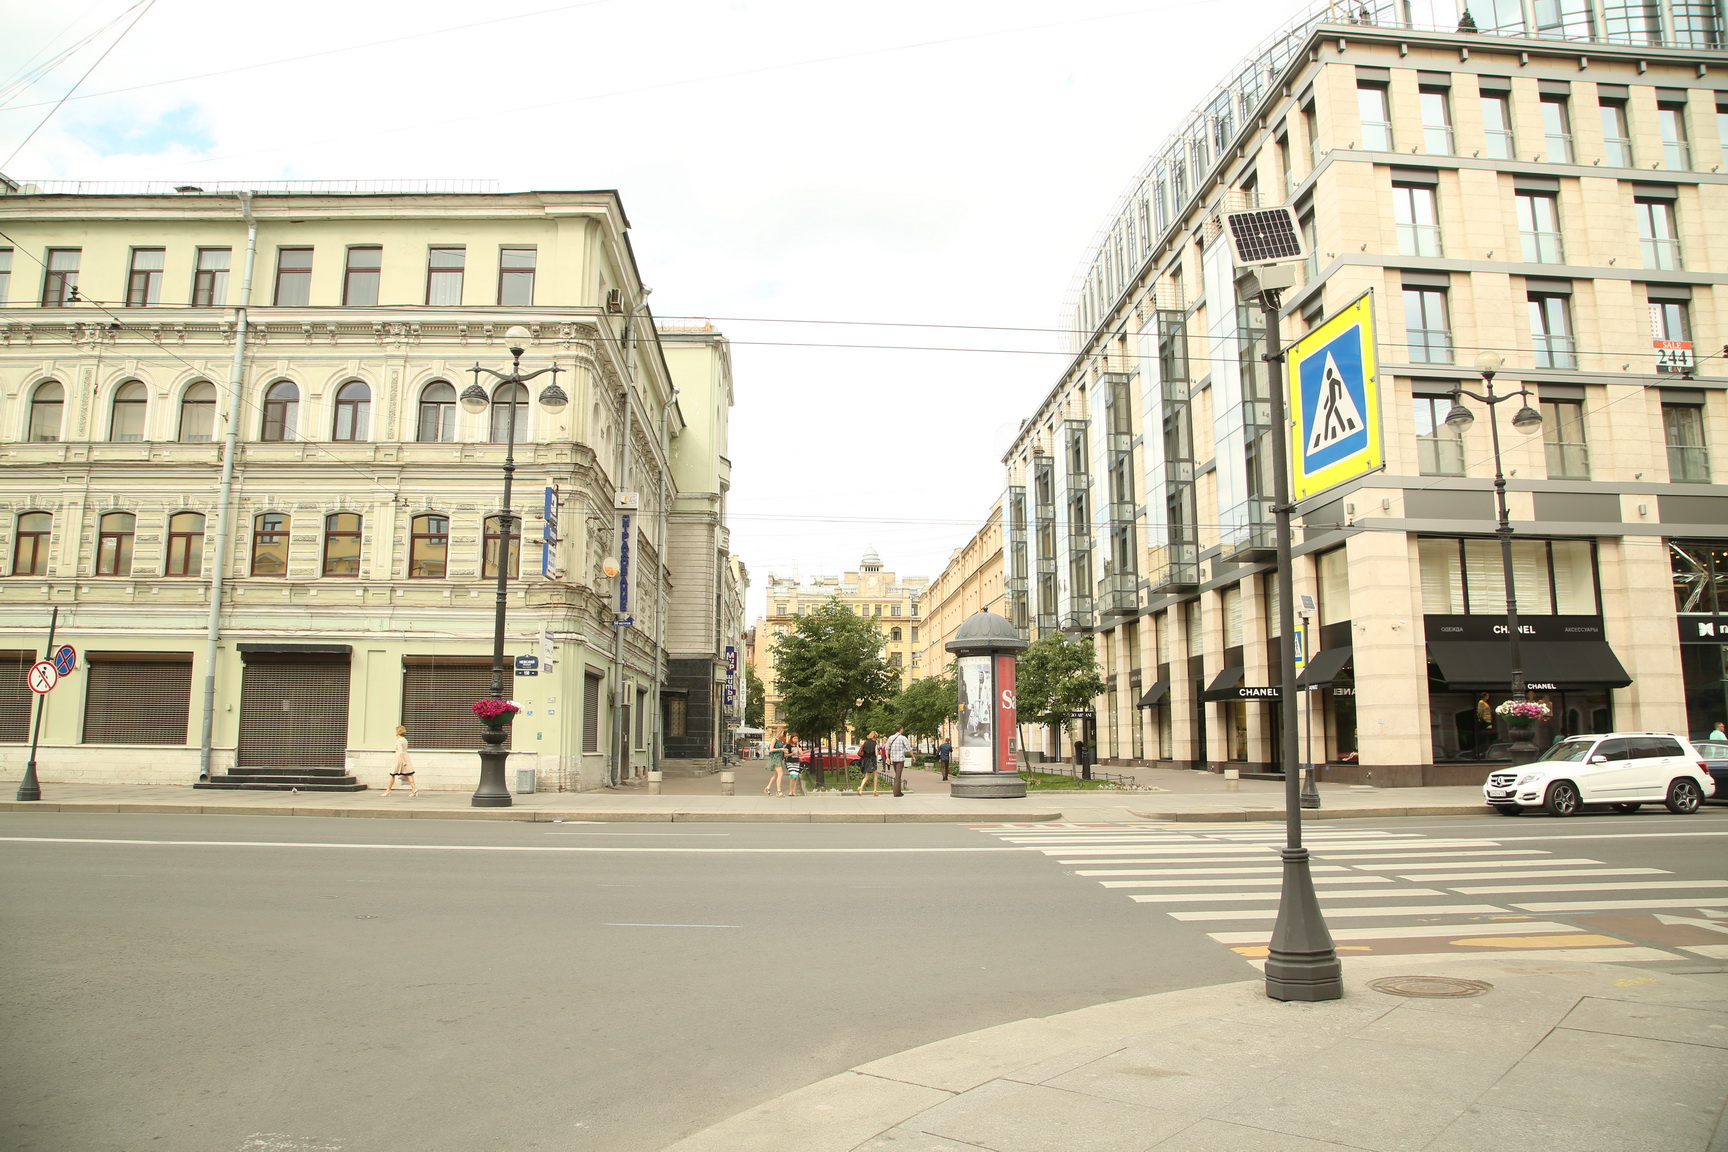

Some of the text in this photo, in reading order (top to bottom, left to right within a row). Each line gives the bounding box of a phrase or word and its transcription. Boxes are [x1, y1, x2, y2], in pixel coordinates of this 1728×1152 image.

[1662, 341, 1682, 349] SALE
[1657, 349, 1688, 366] 244
[620, 514, 630, 611] СТРАХОВАНИЕ
[1493, 625, 1537, 634] CHNEL
[1239, 688, 1279, 696] CHANEL
